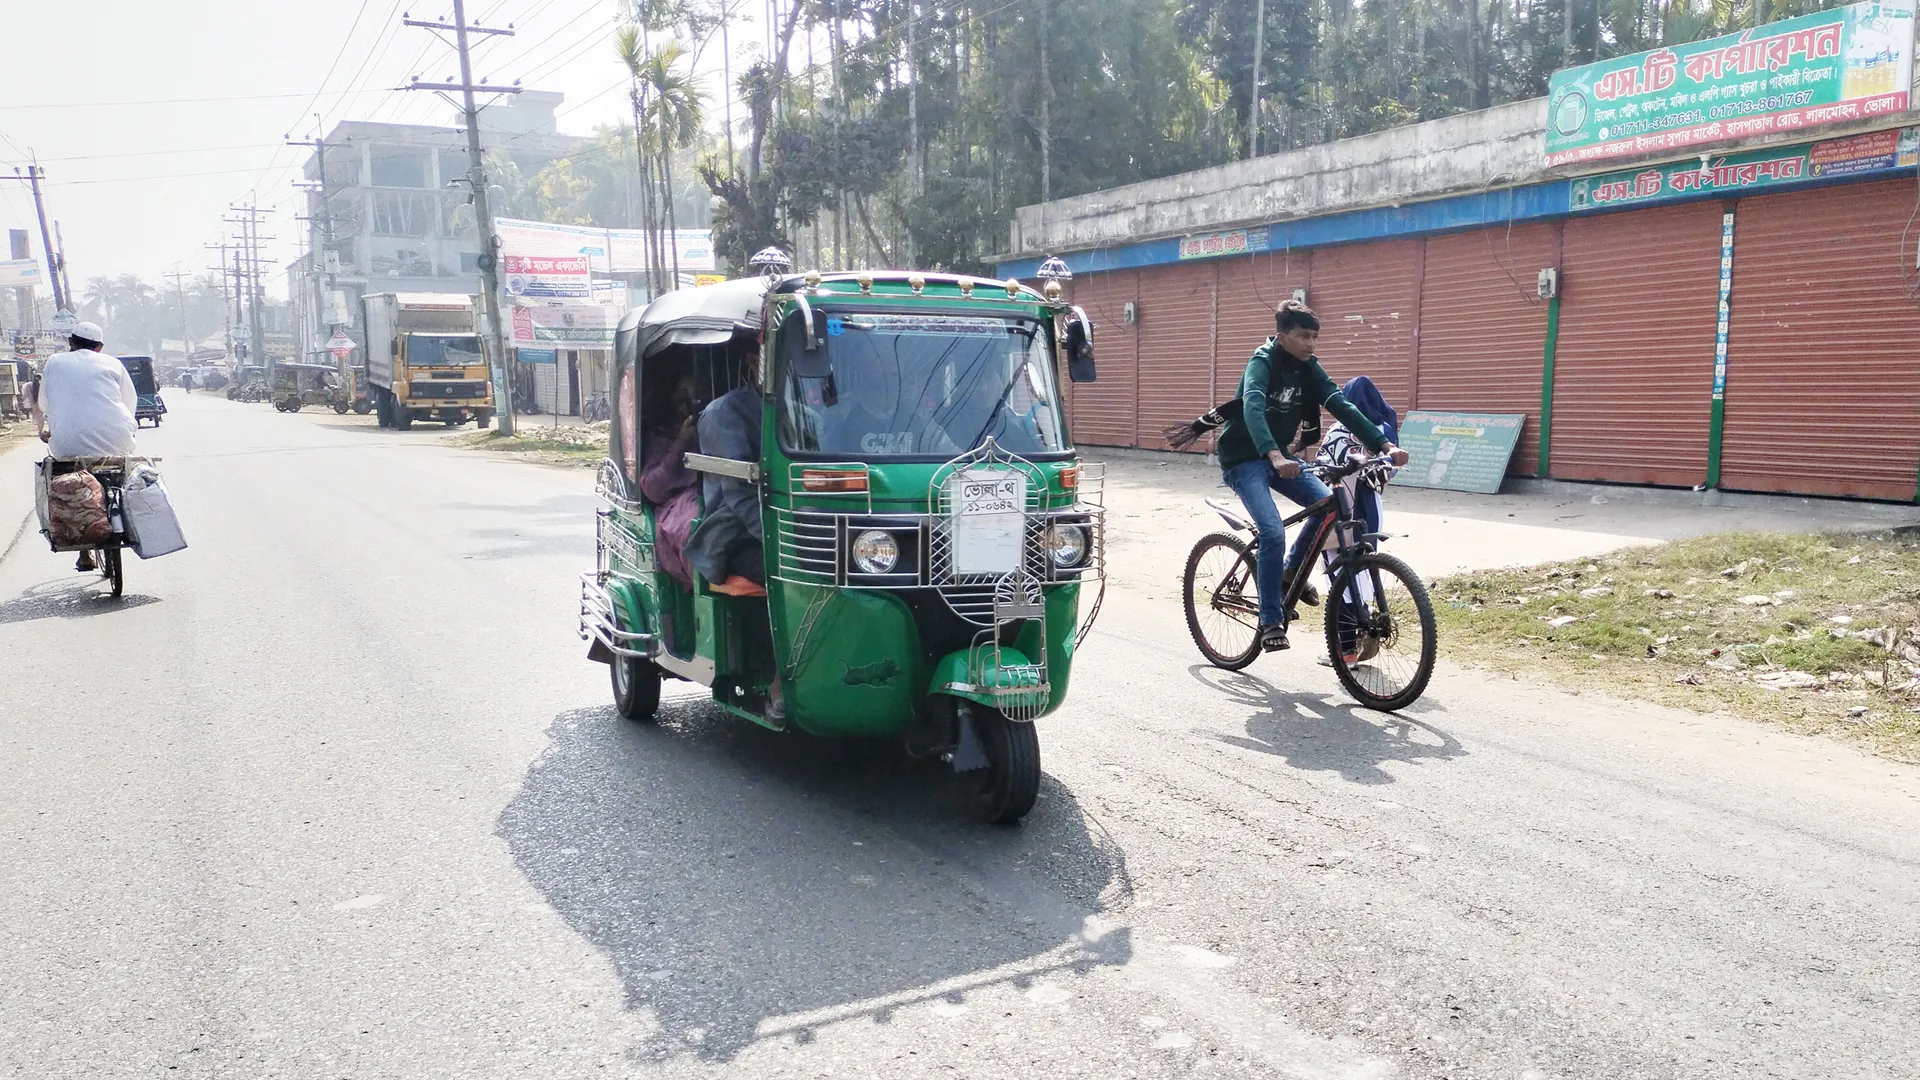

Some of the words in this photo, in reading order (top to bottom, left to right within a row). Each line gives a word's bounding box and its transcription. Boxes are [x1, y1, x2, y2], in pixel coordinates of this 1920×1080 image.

[1594, 47, 1678, 101] এস.টি
[1760, 79, 1767, 90] ও
[1610, 109, 1706, 137] 01711-347631,
[1710, 89, 1814, 119] 01713-861767
[1635, 136, 1666, 151] ইসলাম
[1667, 130, 1691, 147] সুপার
[1727, 116, 1774, 135] হাসপাতাল
[1776, 112, 1802, 128] রোড,
[1806, 102, 1859, 122] লালমোহন,
[1592, 169, 1662, 203] এস.টি
